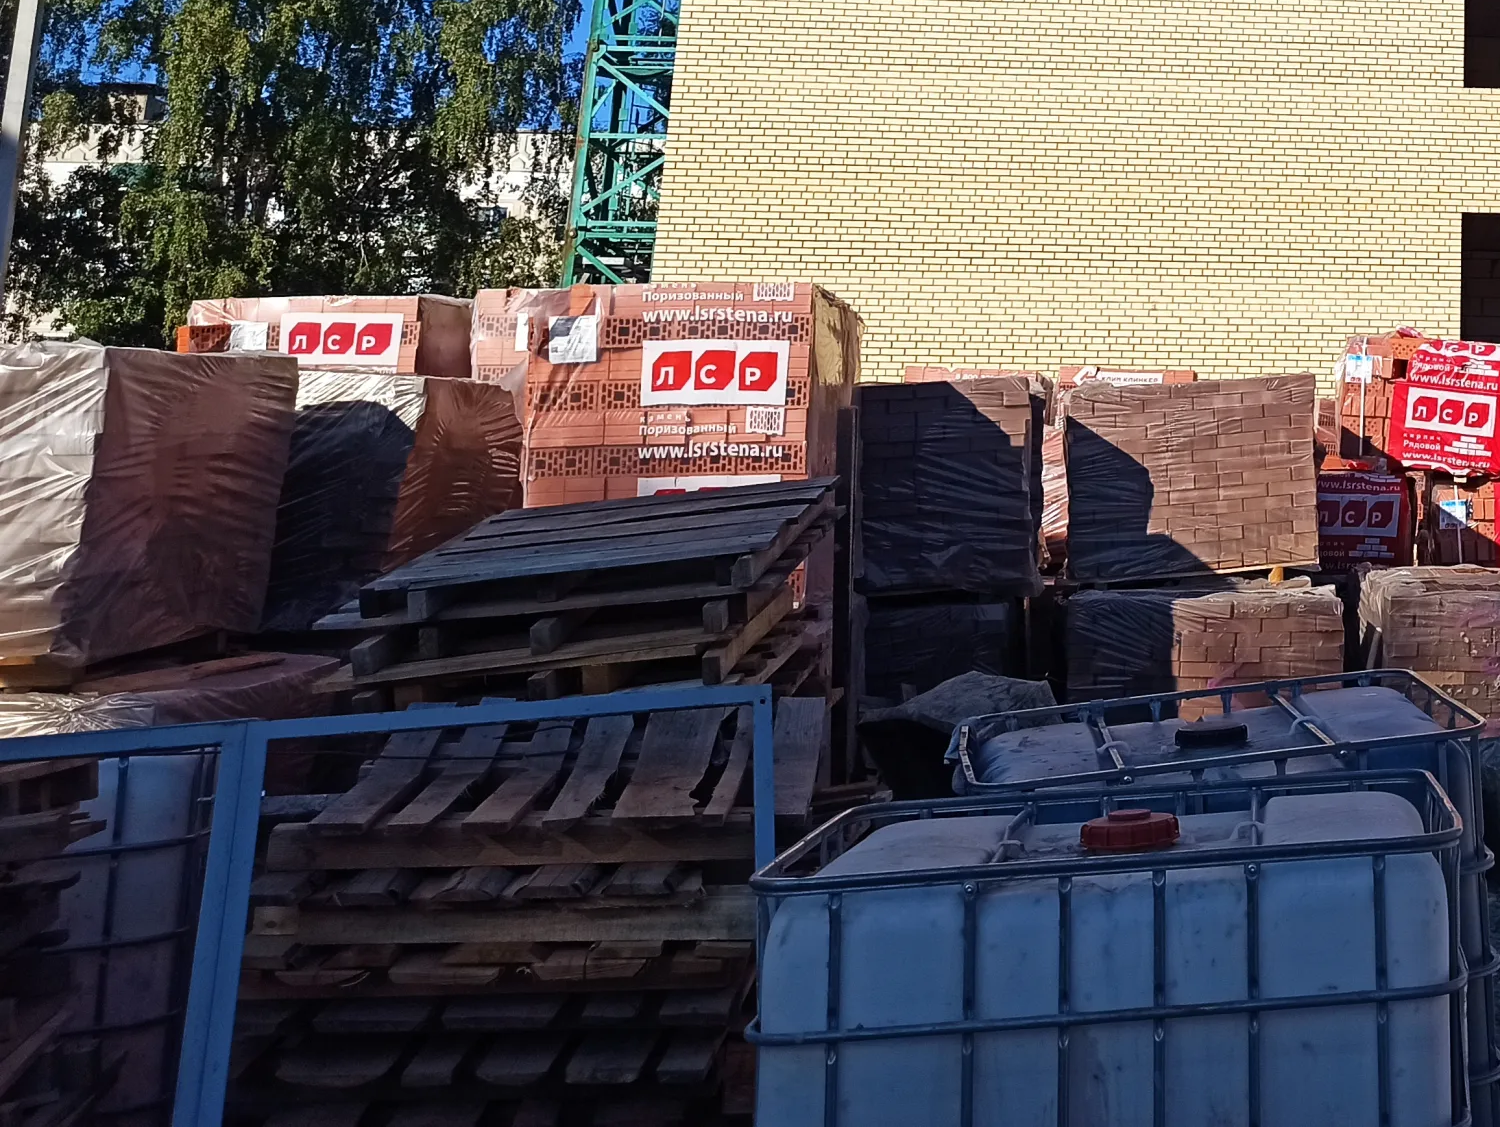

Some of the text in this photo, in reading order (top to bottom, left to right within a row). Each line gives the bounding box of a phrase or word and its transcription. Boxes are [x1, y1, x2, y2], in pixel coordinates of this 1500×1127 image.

[642, 290, 744, 303] Поризованный
[642, 305, 793, 324] www.lsrstena.ru
[290, 333, 377, 352] ЛСР
[654, 363, 762, 388] ЛСР
[1410, 373, 1499, 391] www.lsrstena.ru
[1414, 405, 1479, 424] ЛСР
[638, 423, 737, 436] Поризованный
[1403, 433, 1441, 441] кирпич
[638, 439, 784, 459] www.lsrstena.ru
[1403, 439, 1441, 451] Рядовой
[1318, 480, 1400, 492] ww.lsrstena.ru
